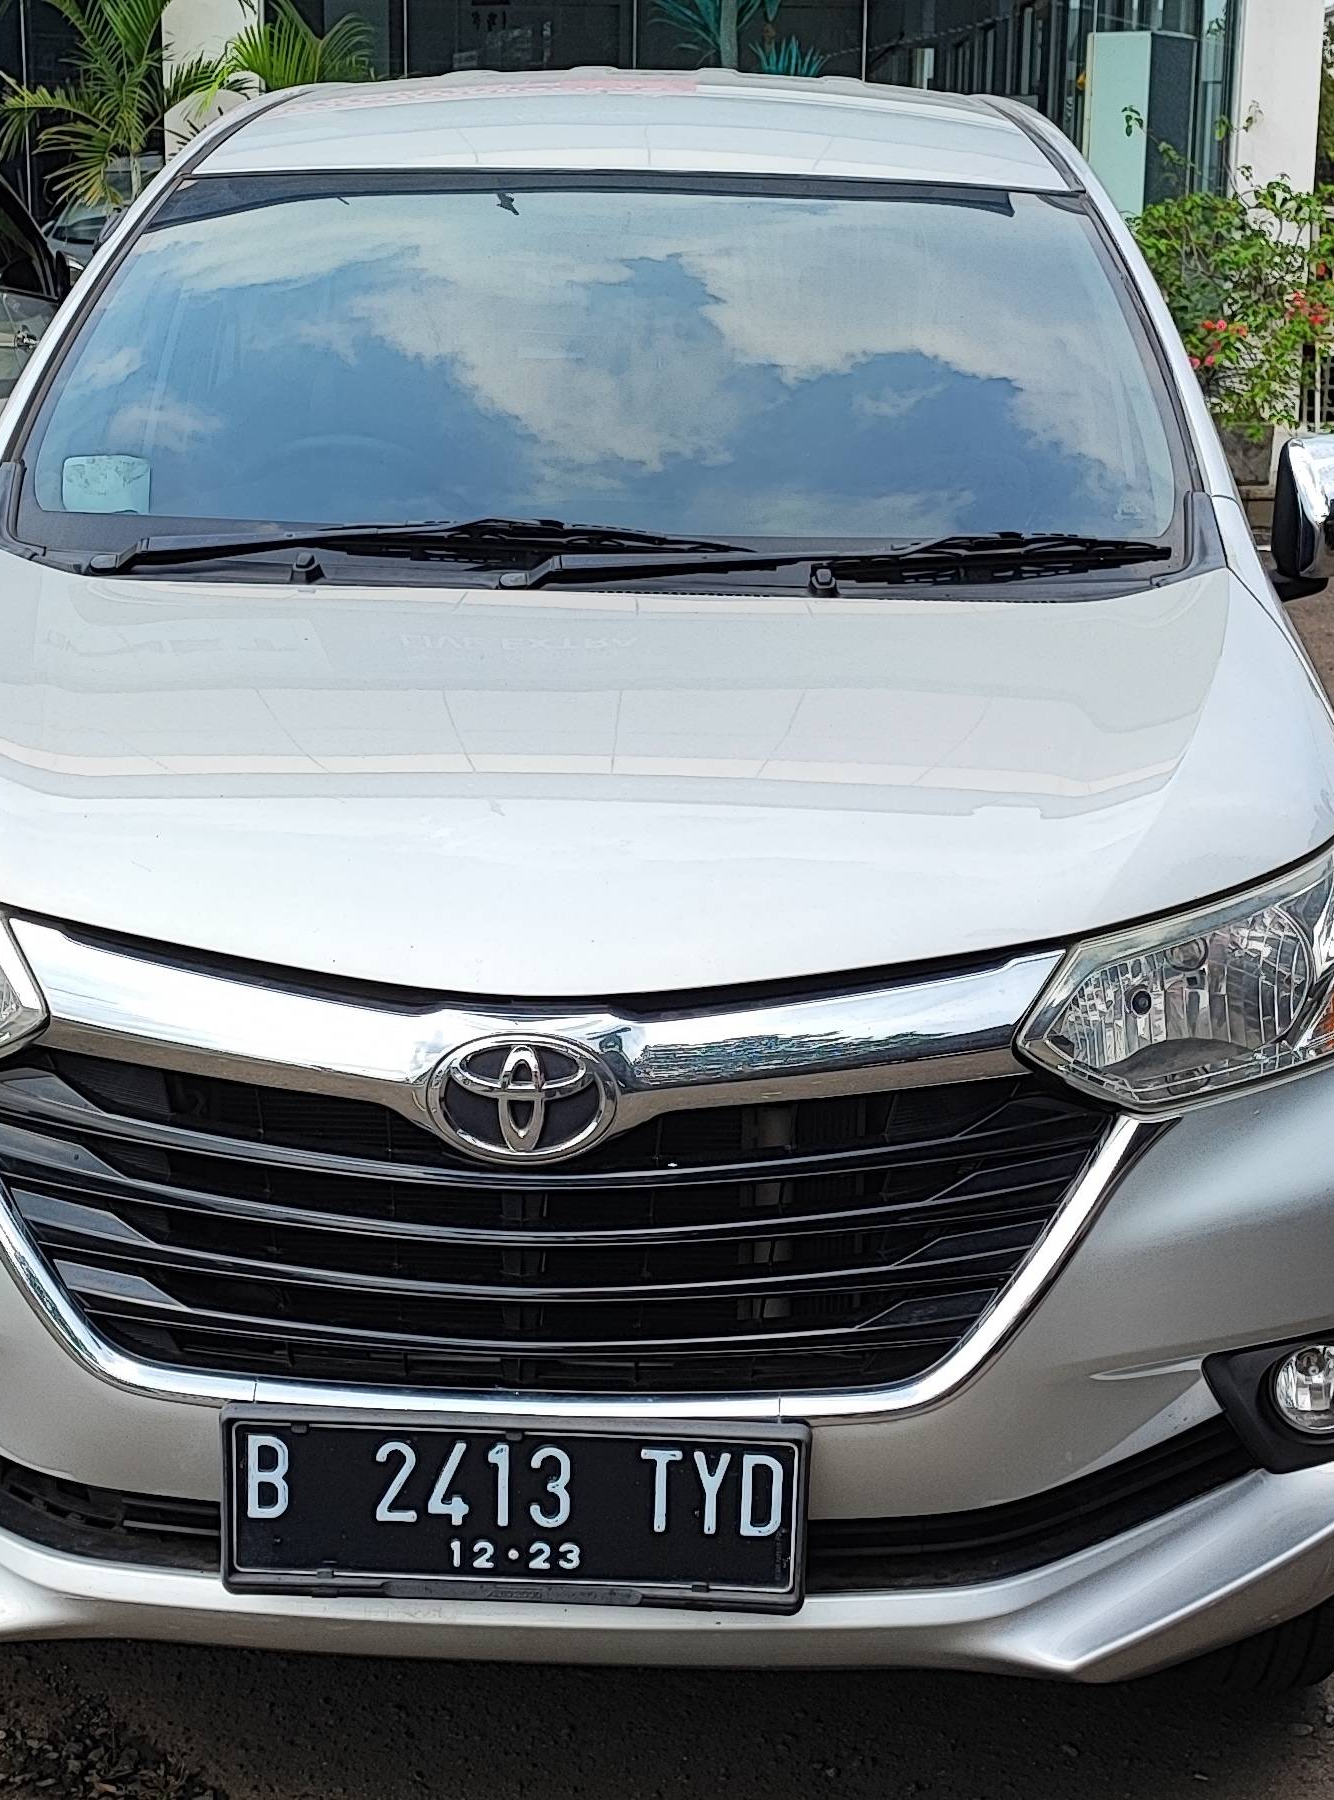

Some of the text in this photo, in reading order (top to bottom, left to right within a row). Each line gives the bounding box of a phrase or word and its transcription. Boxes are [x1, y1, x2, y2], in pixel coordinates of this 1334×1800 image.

[246, 1433, 785, 1537] B 2413 TYD
